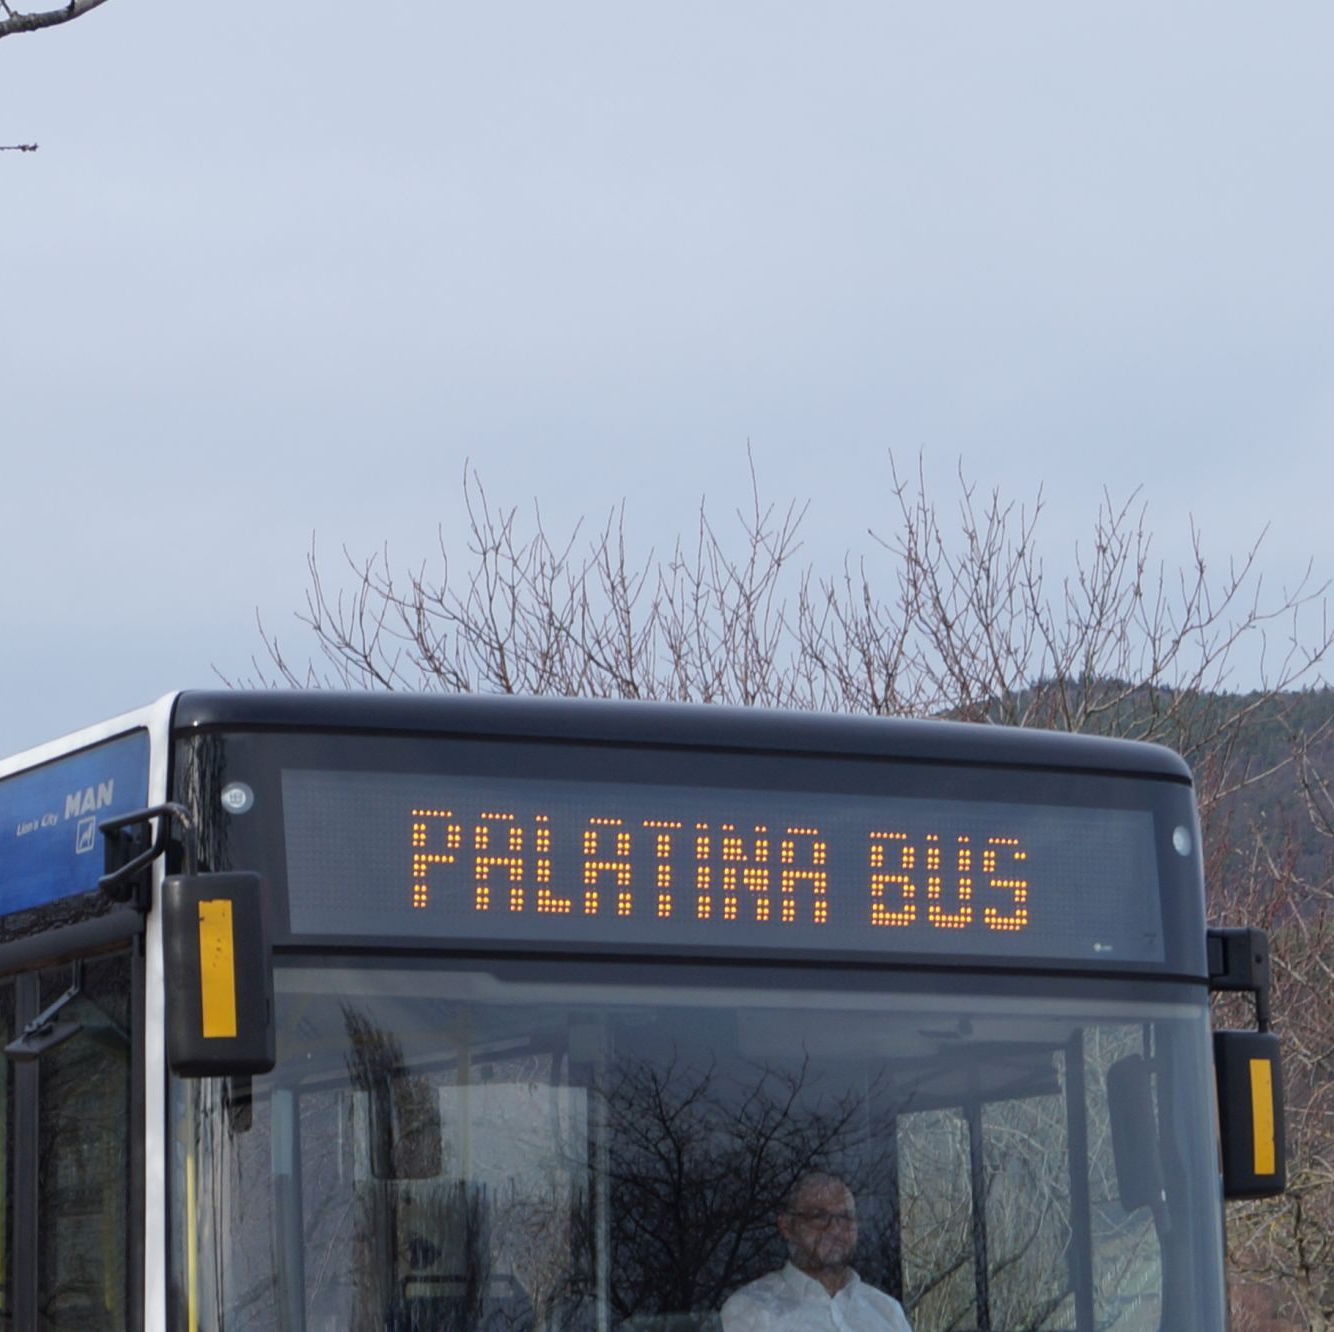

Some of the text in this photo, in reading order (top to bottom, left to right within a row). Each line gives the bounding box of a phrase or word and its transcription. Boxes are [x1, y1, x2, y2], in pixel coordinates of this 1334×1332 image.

[65, 779, 114, 820] MAN
[41, 813, 59, 828] City
[412, 809, 1028, 931] PALATINA BUS
